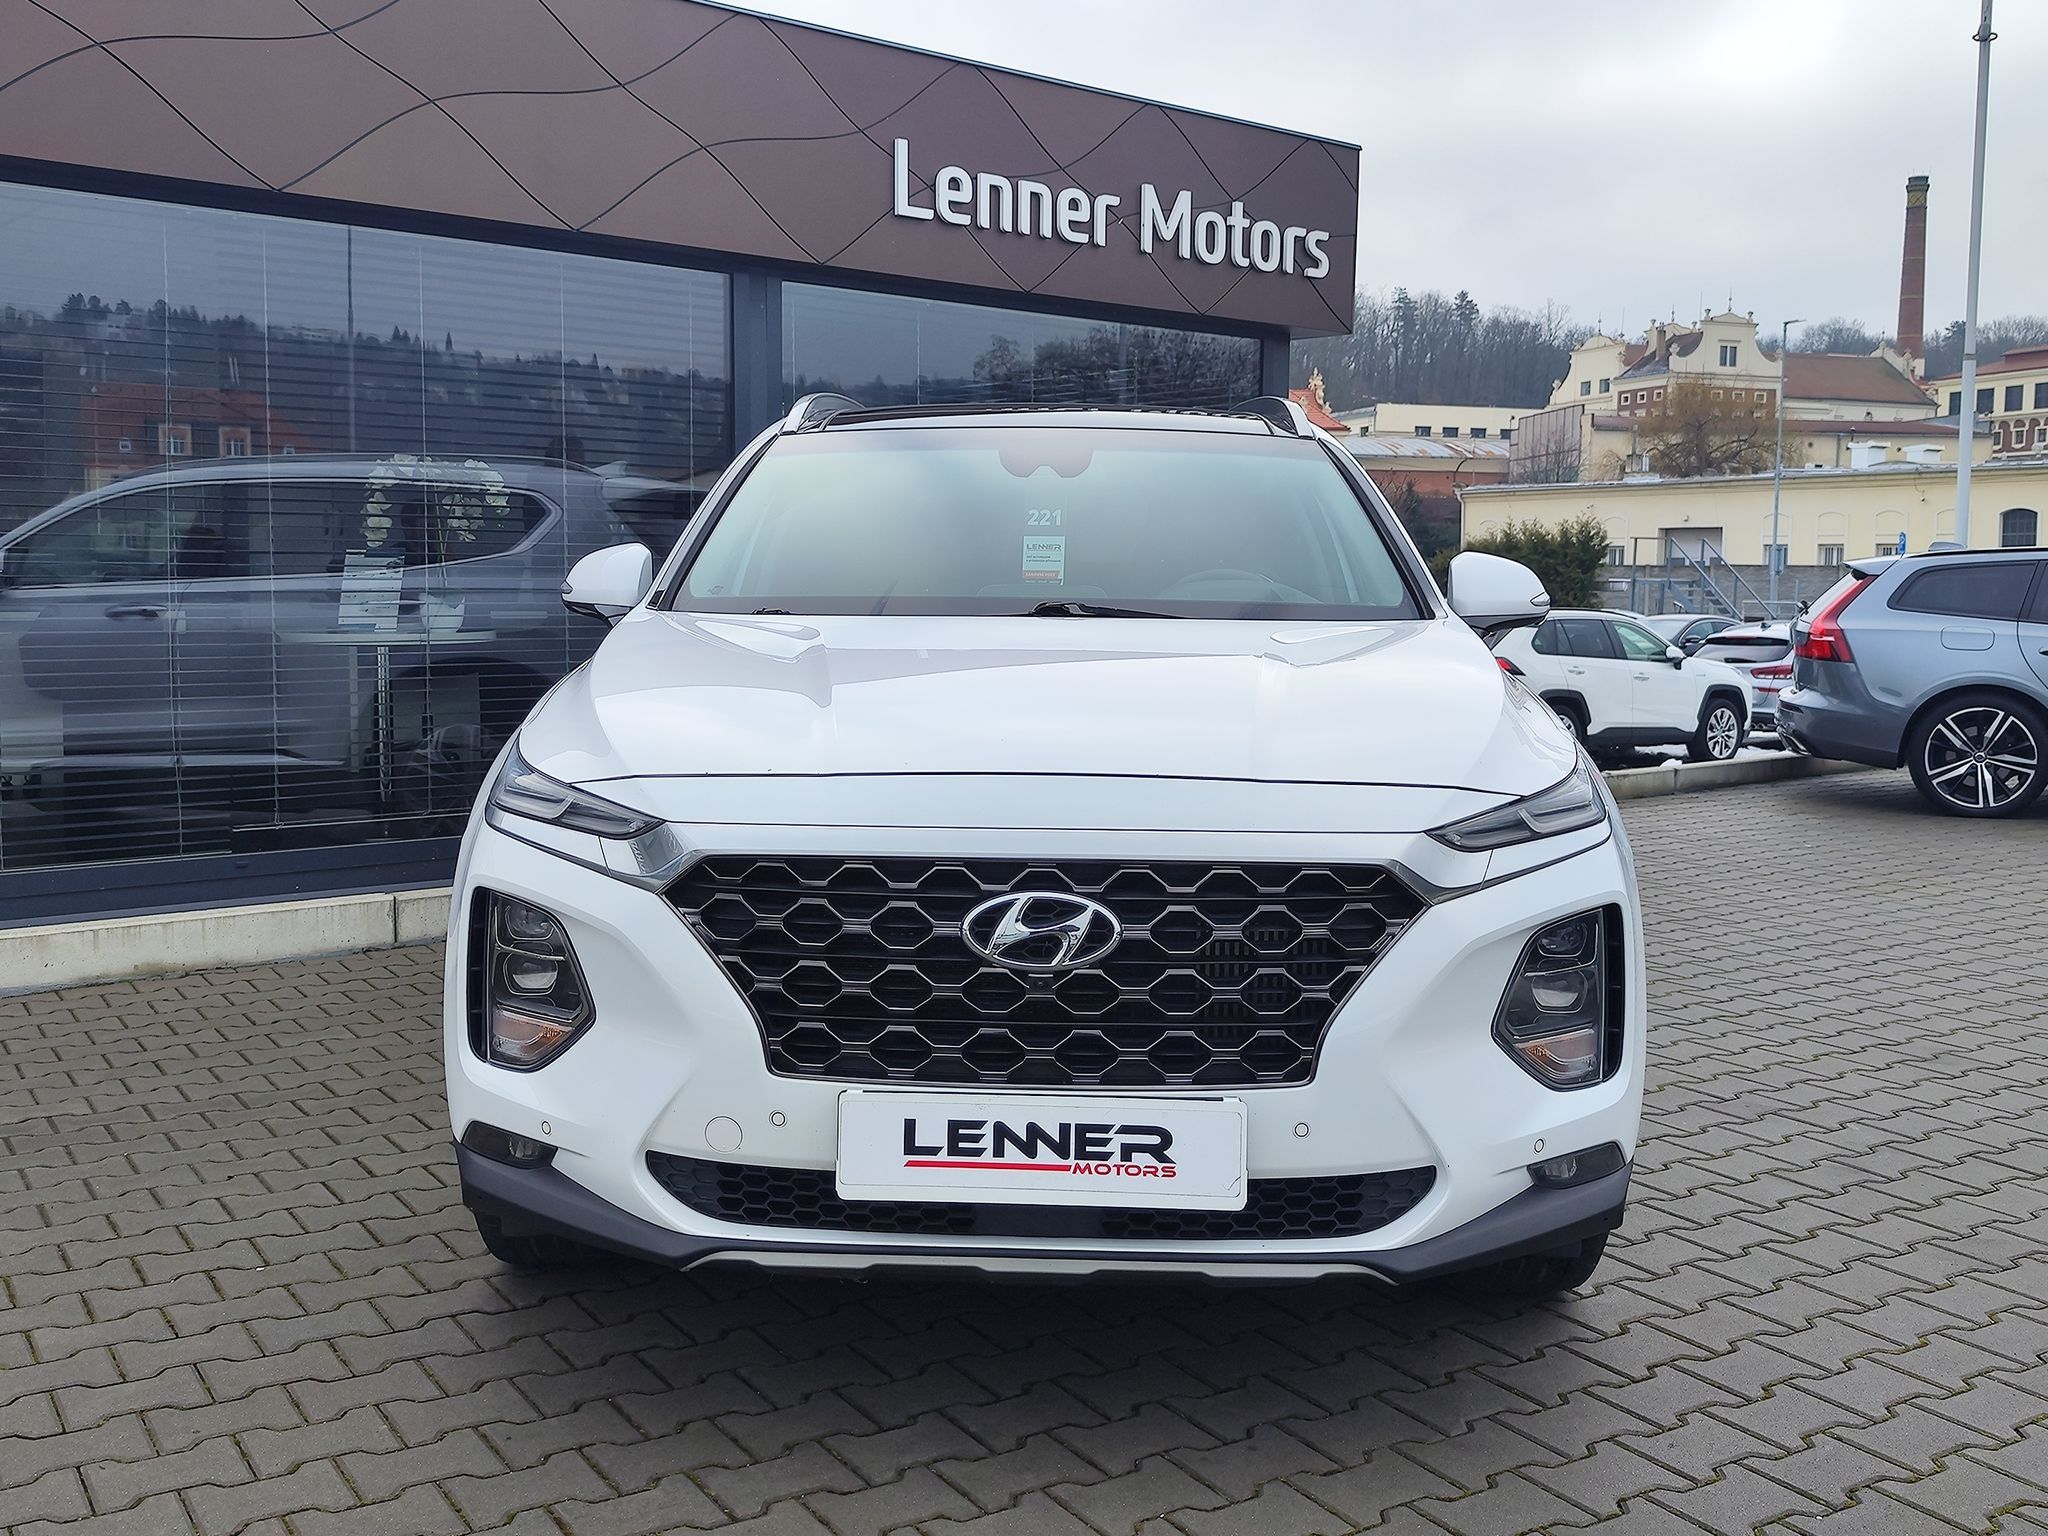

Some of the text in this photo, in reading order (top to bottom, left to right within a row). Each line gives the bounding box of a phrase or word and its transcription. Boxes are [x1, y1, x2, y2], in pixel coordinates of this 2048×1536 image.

[893, 137, 1331, 280] Lenner Motors
[1028, 508, 1062, 526] 221
[903, 1117, 1177, 1164] LENNER
[1072, 1161, 1177, 1178] MOTORS
